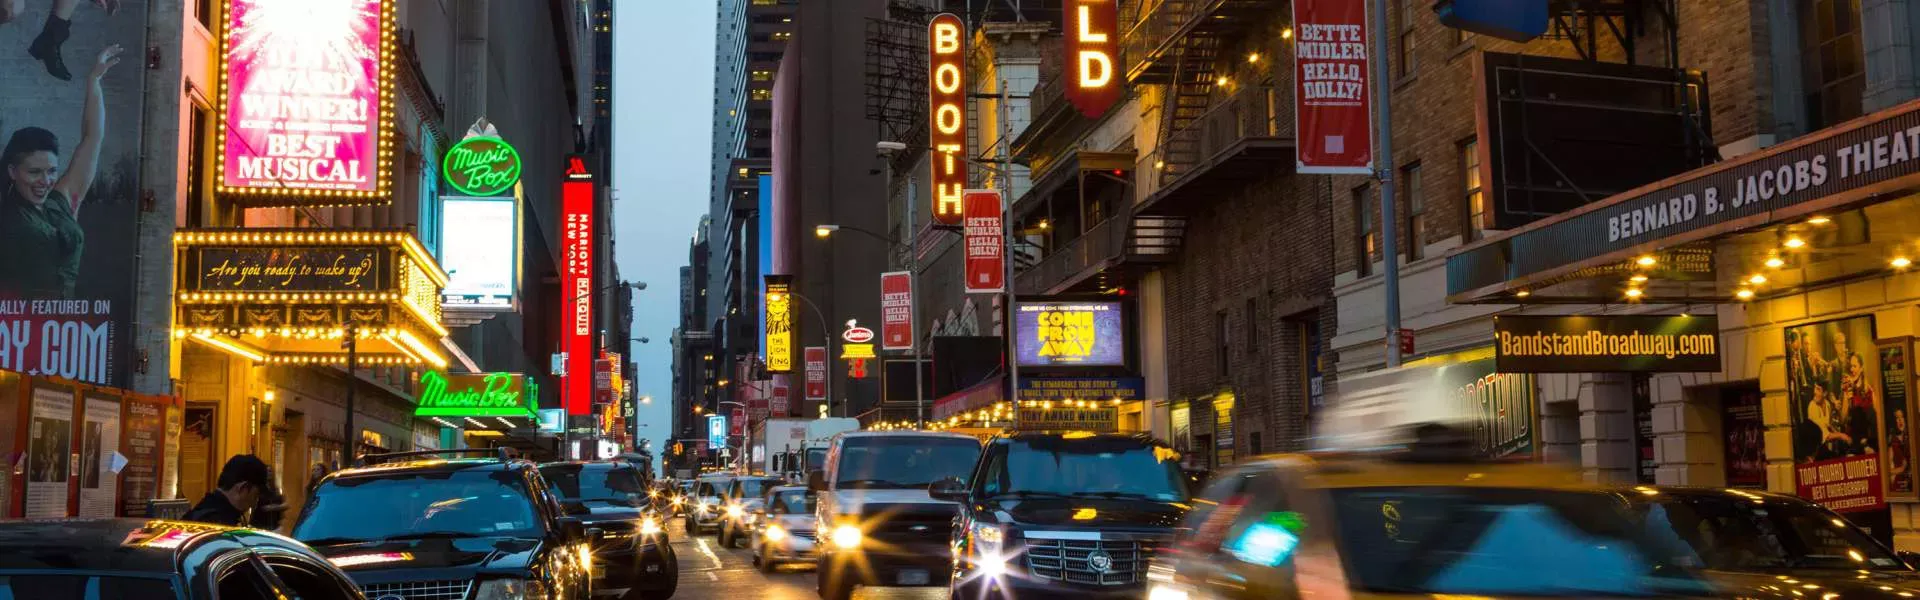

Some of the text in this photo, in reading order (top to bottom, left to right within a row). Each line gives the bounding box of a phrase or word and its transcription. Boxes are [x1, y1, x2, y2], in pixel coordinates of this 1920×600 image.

[1078, 0, 1112, 87] LD
[1301, 24, 1360, 42] BETTE
[1297, 42, 1366, 60] MIDLER
[1303, 63, 1364, 82] HELLO,
[1304, 82, 1362, 100] DOLLY!
[241, 94, 367, 122] WINNER!
[935, 23, 962, 215] BOOTH
[268, 134, 341, 158] BEST
[453, 145, 510, 170] Music
[238, 156, 366, 182] MUSICAL
[463, 165, 515, 188] Box
[1609, 194, 1697, 242] BERNARD
[1704, 187, 1725, 215] B.
[1732, 154, 1828, 208] JACOBS
[567, 214, 576, 239] NEW
[966, 227, 1000, 236] MIDLER
[968, 217, 999, 227] BETTE
[207, 255, 372, 286] Are you ready to wake up?
[578, 214, 588, 334] MARRIOTT MARQUIS
[32, 300, 89, 315] FEATURED
[94, 300, 111, 315] ON
[1038, 311, 1094, 327] COME
[1038, 326, 1095, 342] FROM
[1502, 330, 1715, 359] BandstandBroadway.com
[770, 345, 787, 355] LION
[1038, 340, 1095, 356] AWAY
[768, 355, 789, 369] KING
[420, 370, 519, 406] Music Box
[1798, 458, 1878, 486] TONY AWARD WINNER!
[1812, 485, 1826, 500] BEST
